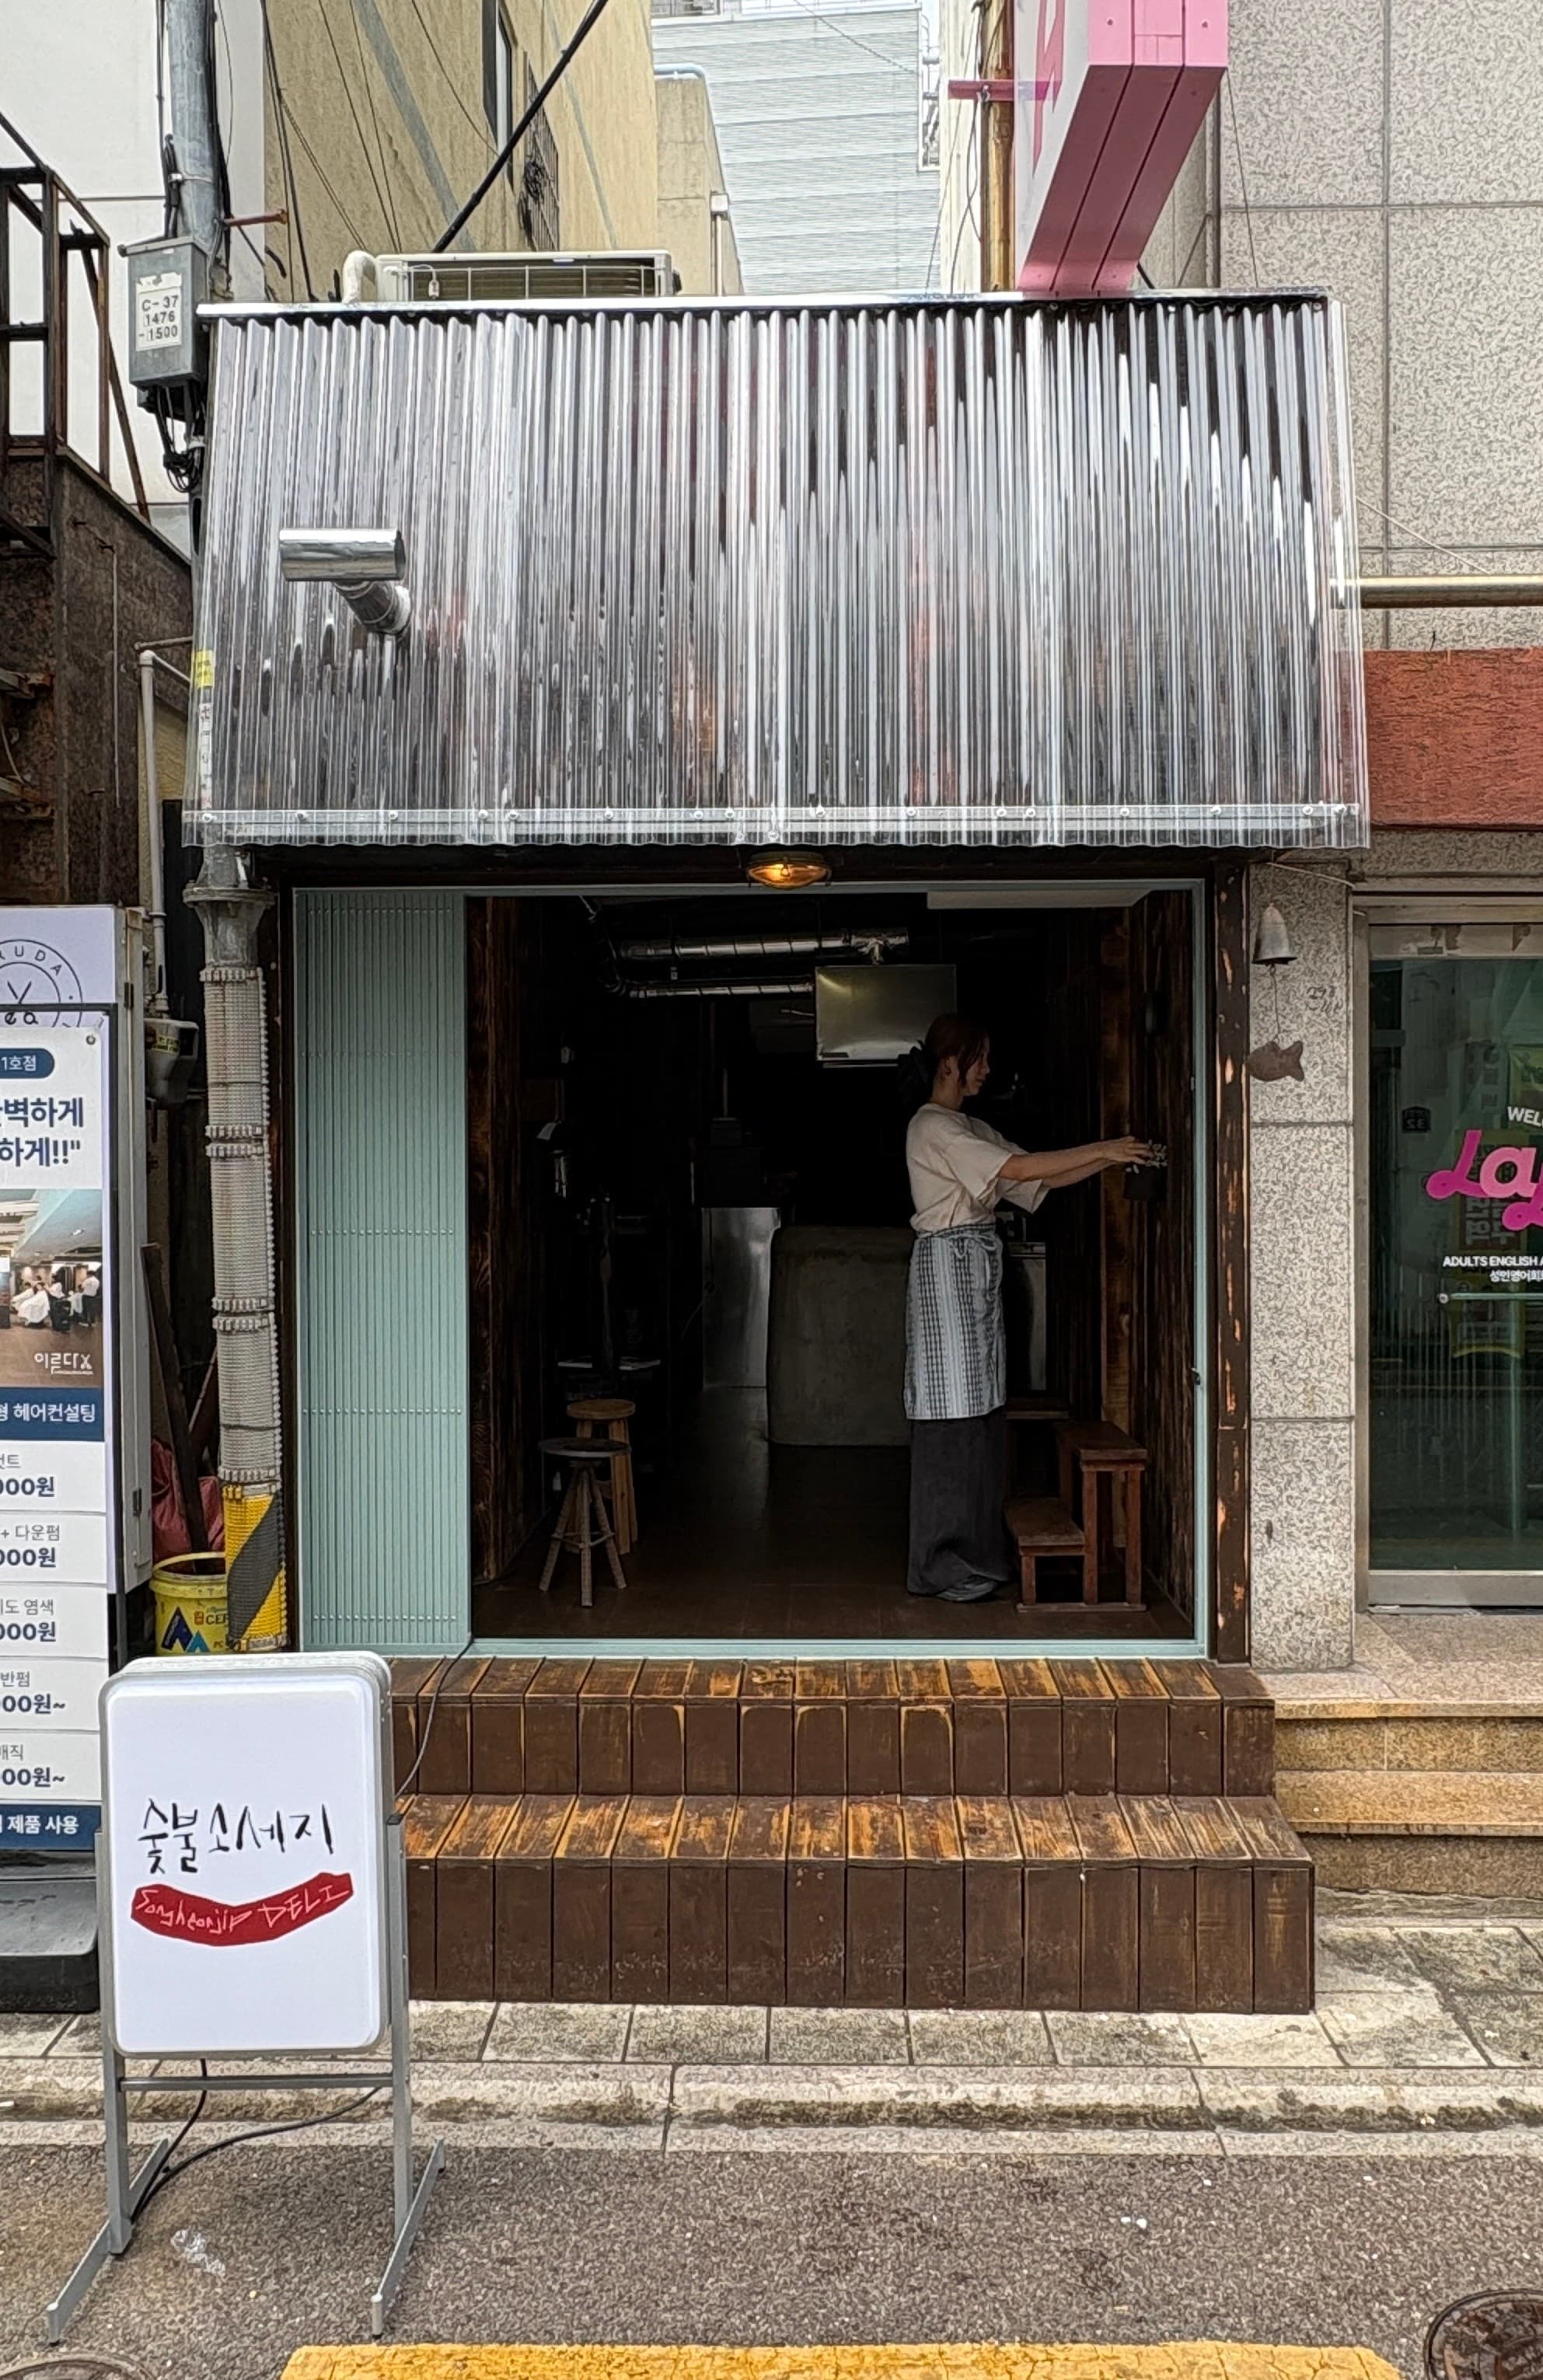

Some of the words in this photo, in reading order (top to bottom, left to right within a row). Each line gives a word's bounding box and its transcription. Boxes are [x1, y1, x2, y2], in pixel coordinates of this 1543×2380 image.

[145, 311, 176, 326] 1476
[2, 1056, 37, 1072] 1호점
[0, 1097, 84, 1128] 벽하게
[1507, 1106, 1543, 1127] WEL
[1443, 1255, 1488, 1267] ADULTS
[1489, 1255, 1538, 1266] ENGLISH
[12, 1403, 96, 1423] 헤어컨설팅
[15, 1523, 61, 1541] 다운펌
[0, 1598, 19, 1614] 도
[24, 1599, 54, 1616] 염색
[1, 1671, 30, 1687] 반펌
[7, 1814, 41, 1834] 제품
[44, 1815, 79, 1835] 사용
[257, 1885, 350, 1928] DELI
